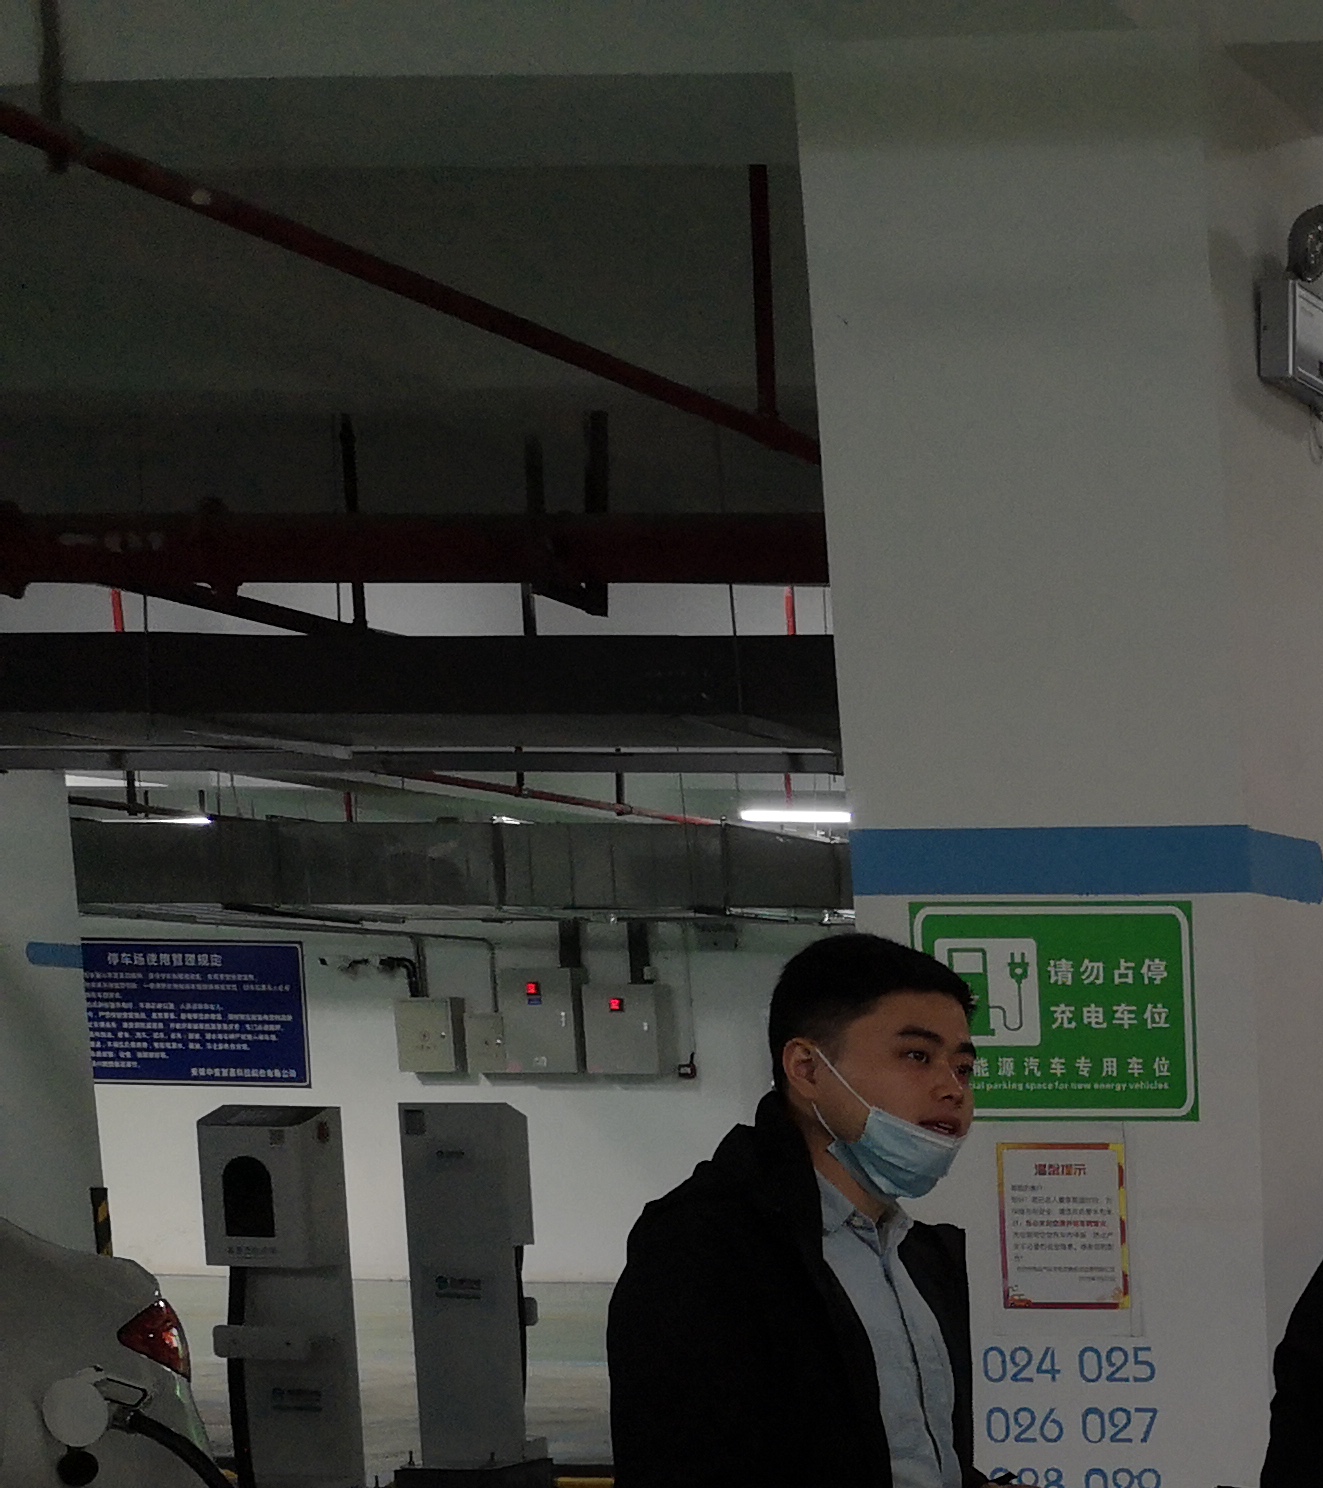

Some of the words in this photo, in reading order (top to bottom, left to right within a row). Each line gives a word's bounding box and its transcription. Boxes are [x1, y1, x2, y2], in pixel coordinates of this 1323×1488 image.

[1047, 958, 1168, 986] 请勿占停
[1050, 1003, 1170, 1029] 充电车位
[973, 1056, 1171, 1077] 能源汽车专用车位
[982, 1346, 1061, 1383] 024
[1078, 1346, 1156, 1383] 025
[986, 1406, 1064, 1443] 026
[1081, 1406, 1158, 1444] 027
